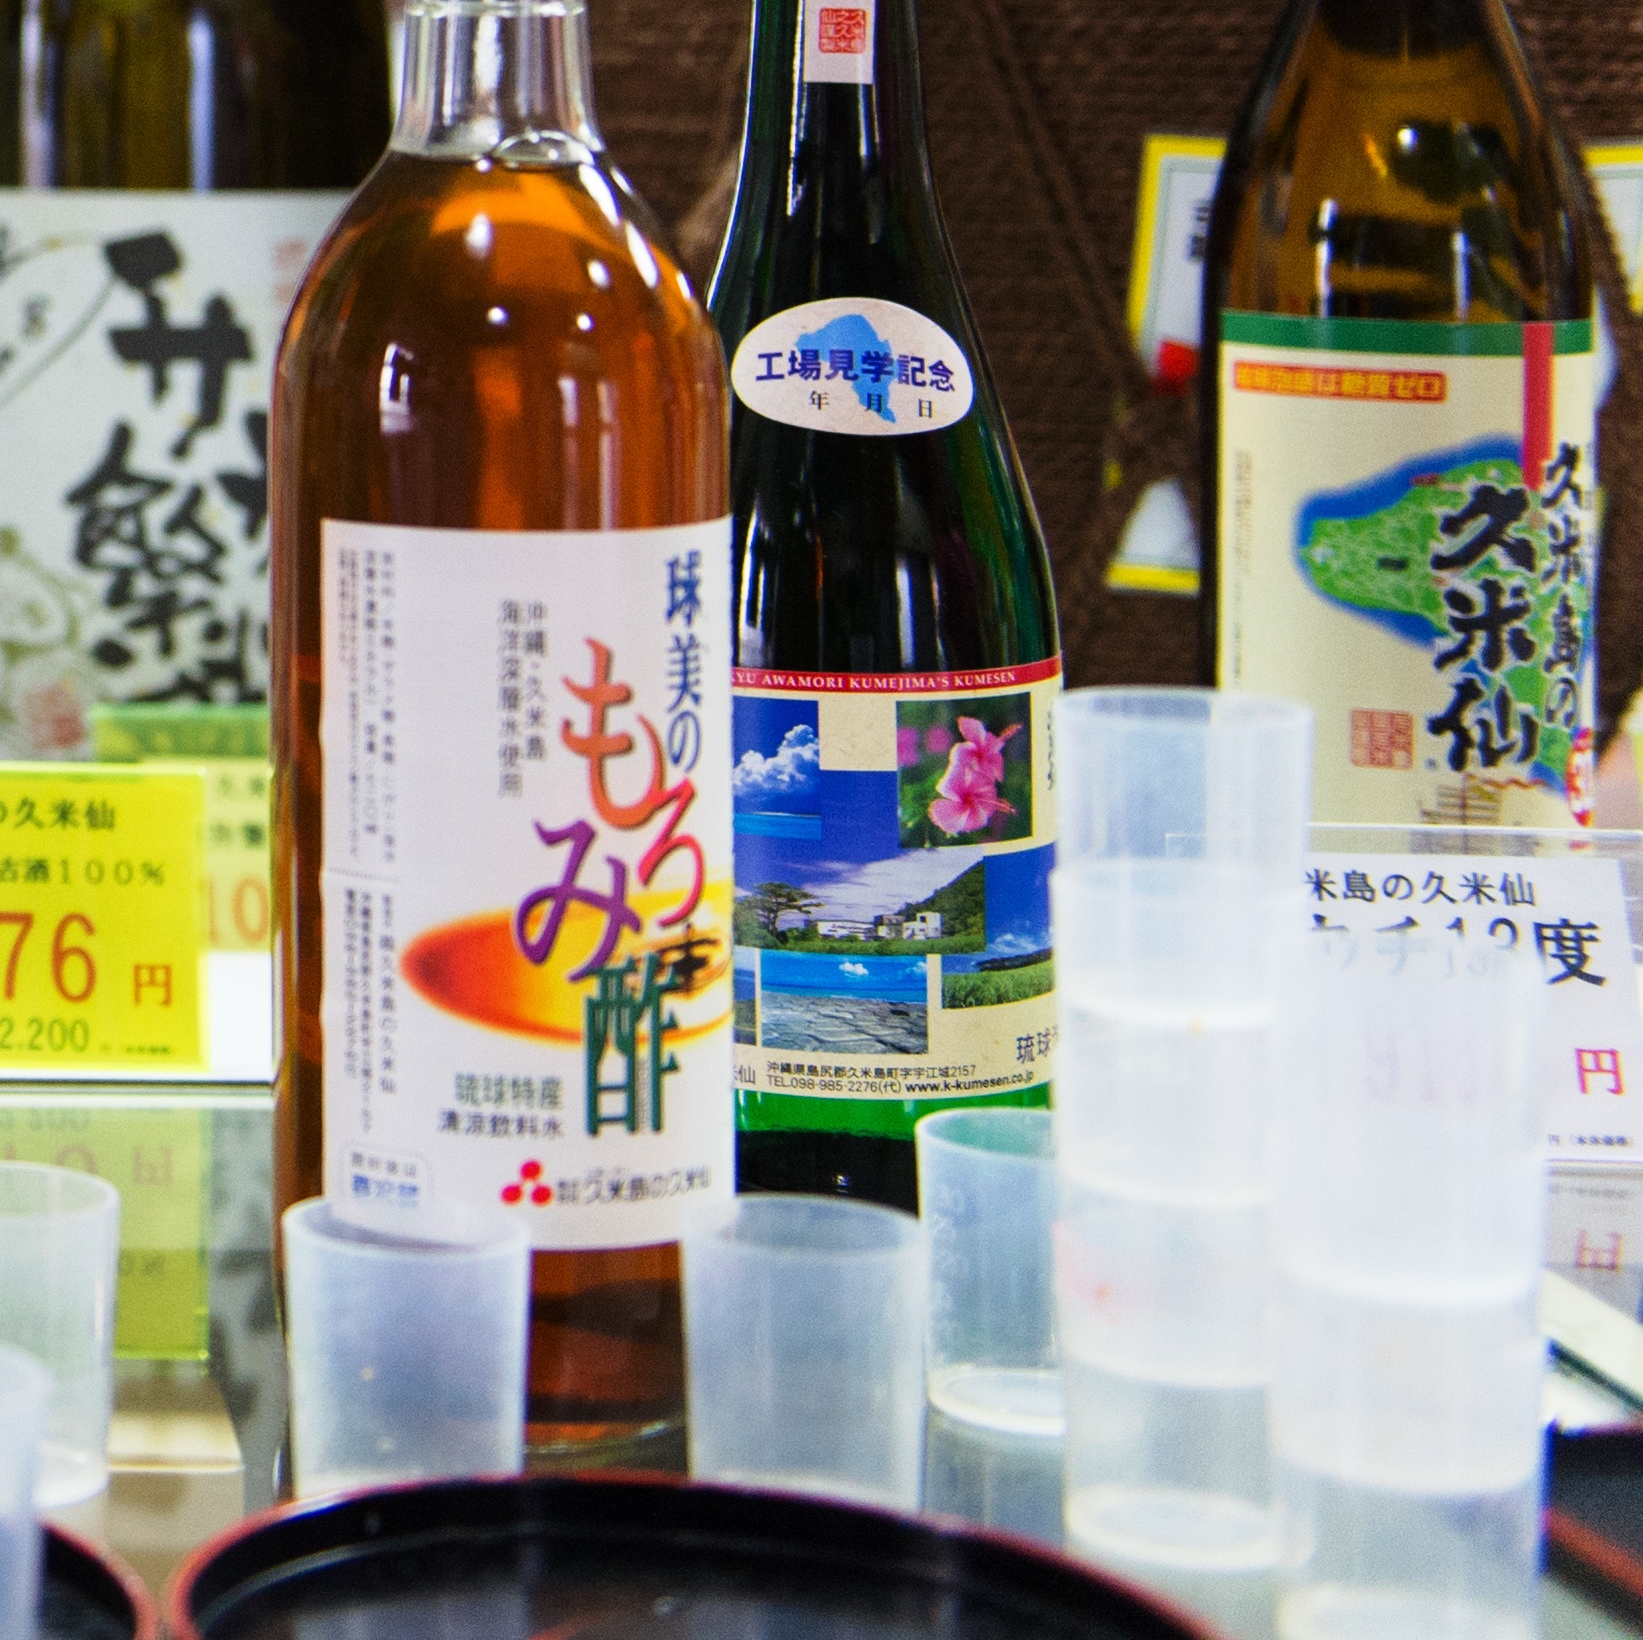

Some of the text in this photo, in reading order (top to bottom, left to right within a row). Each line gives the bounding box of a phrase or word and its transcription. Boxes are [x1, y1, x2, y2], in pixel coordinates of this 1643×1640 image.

[755, 348, 956, 393] 工場見学記念
[809, 389, 933, 419] 年 月 日
[1541, 442, 1583, 728] 久米島の
[1426, 483, 1541, 773] 久米仙
[666, 550, 703, 772] 球美の
[733, 670, 1016, 691] YU AWAMORI KUMEJIMA'S KUMESEN
[515, 637, 707, 1136] もろみ酢
[1305, 868, 1538, 907] 米島の久米仙
[132, 962, 174, 1008] 円
[734, 1063, 756, 1085] 仙
[1574, 1047, 1625, 1096] 円
[437, 1108, 563, 1141] 清涼飲料水
